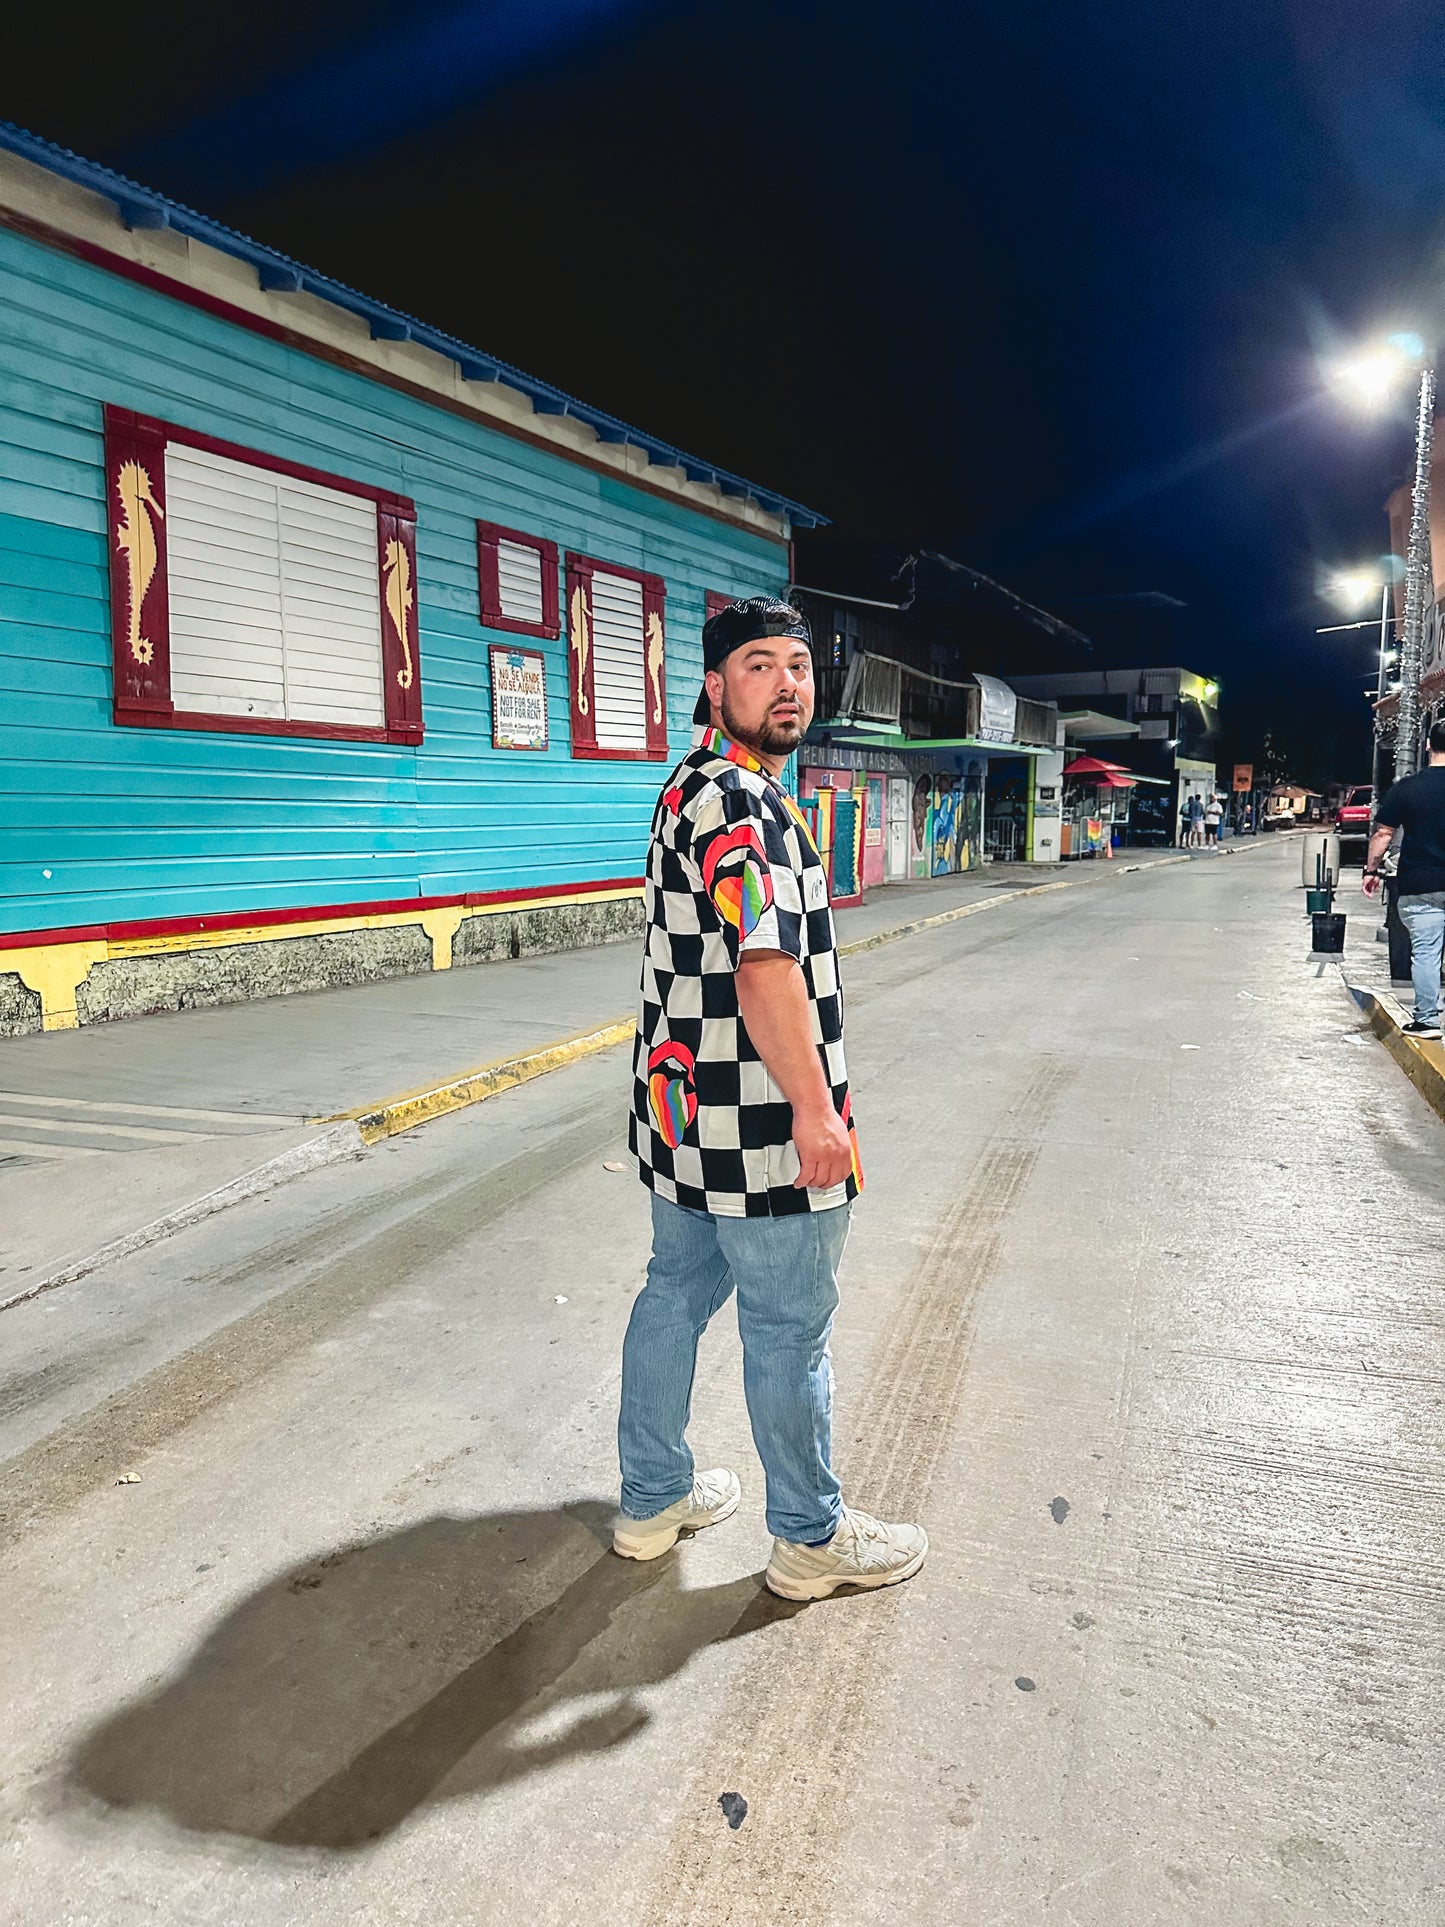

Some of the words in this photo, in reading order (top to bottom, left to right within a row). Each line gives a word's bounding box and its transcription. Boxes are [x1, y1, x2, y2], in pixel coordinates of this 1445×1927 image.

[500, 670, 508, 680] NO
[512, 670, 519, 681] SE
[521, 672, 540, 684] VENDE
[498, 679, 507, 691] NO
[509, 680, 516, 691] SE
[500, 696, 513, 706] NOT
[515, 697, 526, 707] FOR
[527, 698, 540, 709] SALE
[500, 707, 514, 717] NOT
[515, 708, 526, 718] FOR
[527, 710, 541, 720] RENT
[804, 745, 844, 766] RENTAL
[850, 751, 886, 770] KAYAKS
